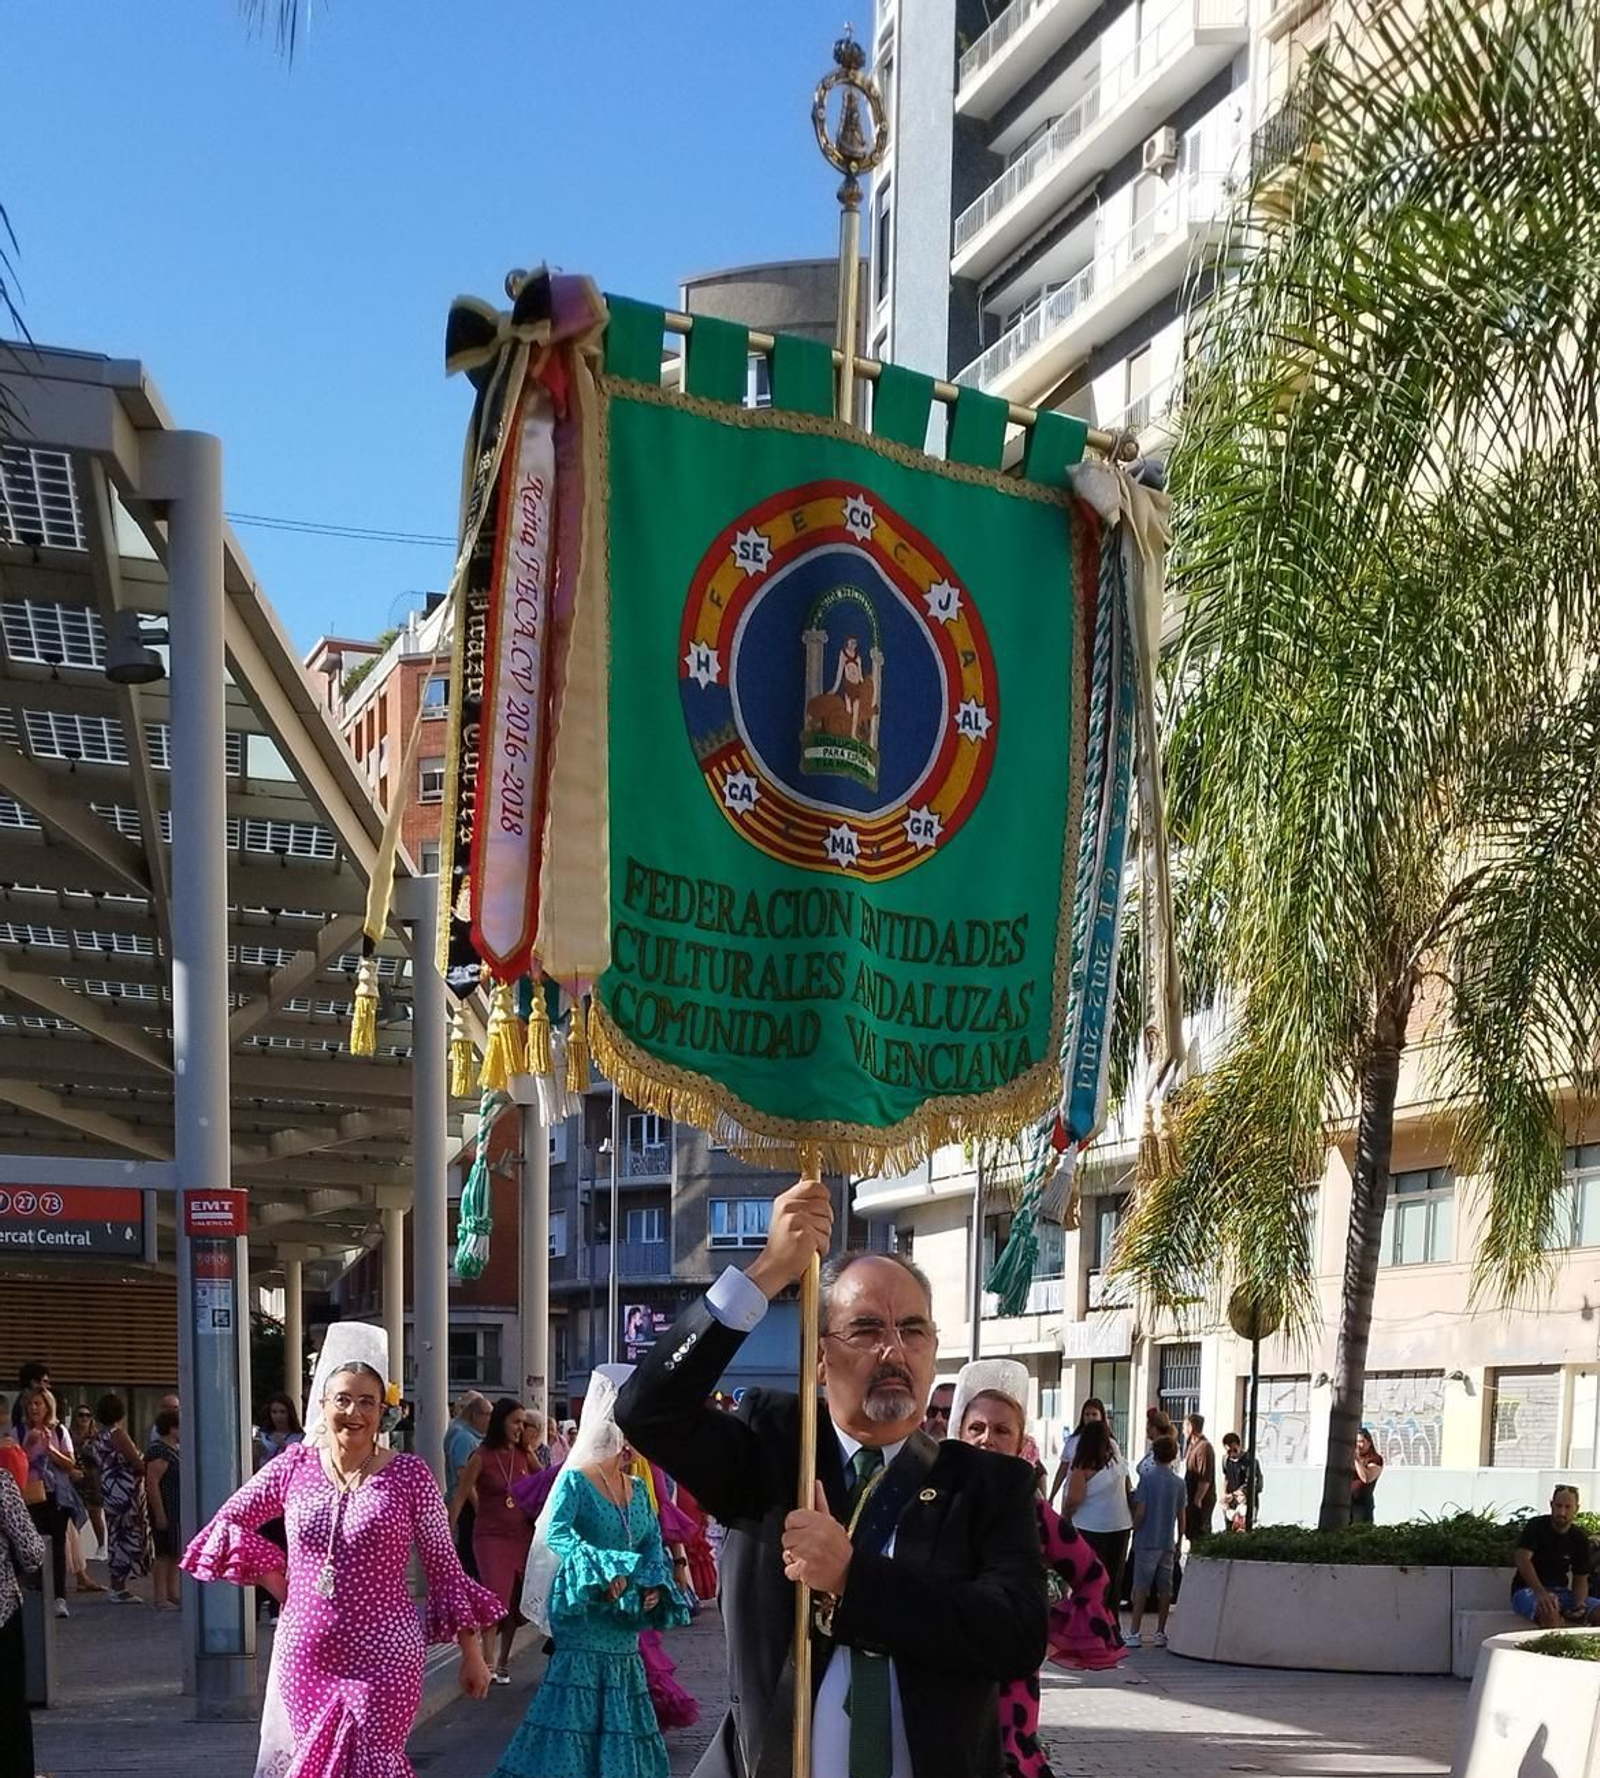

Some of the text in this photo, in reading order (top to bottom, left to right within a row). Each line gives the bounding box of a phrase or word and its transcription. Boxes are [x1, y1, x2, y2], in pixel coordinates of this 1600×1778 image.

[519, 473, 544, 547] Reina
[849, 508, 871, 527] CO
[791, 512, 805, 534] E
[739, 543, 765, 562] SE
[938, 593, 951, 611] J
[697, 656, 710, 674] H
[961, 651, 975, 667] A
[961, 711, 982, 730] AL
[501, 696, 530, 836] 2016-2018
[728, 781, 752, 801] CA
[910, 819, 935, 838] GR
[831, 836, 855, 856] MA
[623, 856, 1029, 968] FEDERACION ENTIDADES
[611, 922, 1036, 1034] CULTURALES ANDALUZAS
[1077, 942, 1111, 1090] 2012-2014
[612, 982, 1034, 1090] COMUNIDAD VALENCIANA
[190, 1201, 234, 1211] EMT
[38, 1229, 92, 1246] Central
